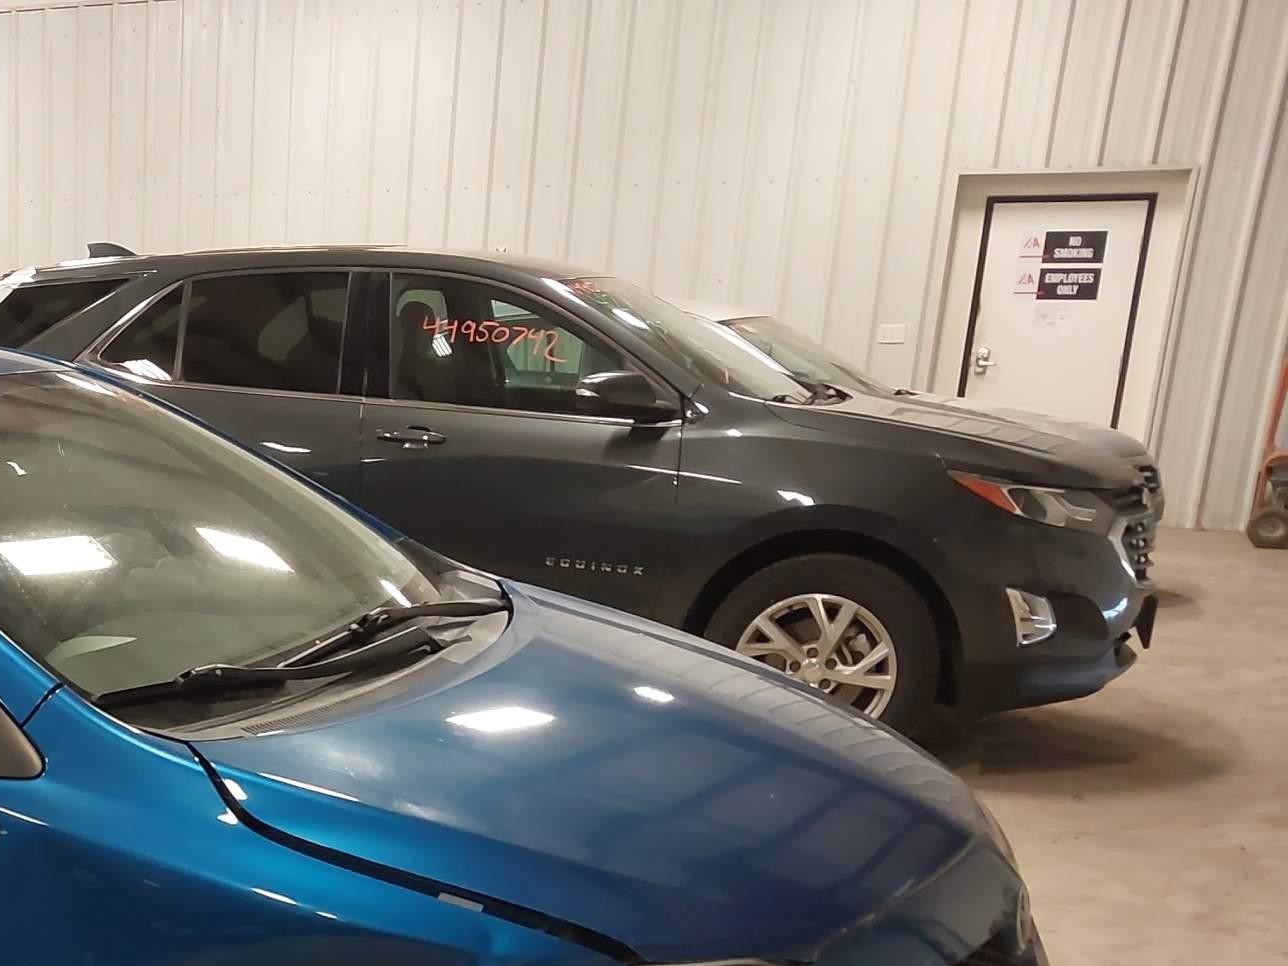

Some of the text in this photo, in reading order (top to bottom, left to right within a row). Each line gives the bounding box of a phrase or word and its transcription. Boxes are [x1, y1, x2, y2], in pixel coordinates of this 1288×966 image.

[1069, 236, 1082, 246] NO
[1054, 248, 1094, 258] SMOKING
[1044, 273, 1094, 283] EMPLOYEES
[1056, 284, 1079, 295] ONLY
[423, 316, 566, 362] 44950742
[545, 556, 644, 575] EQUINOX
